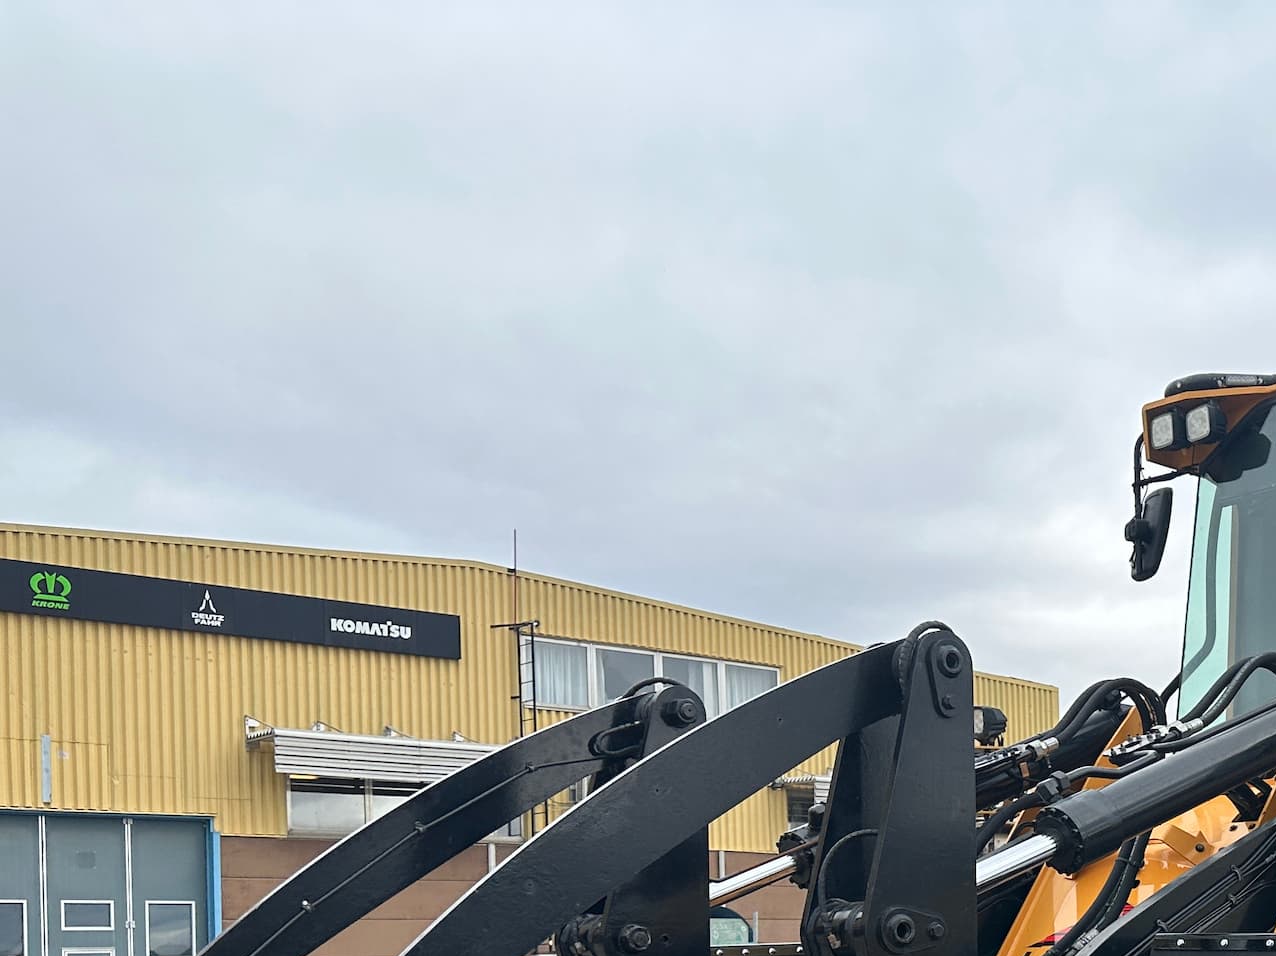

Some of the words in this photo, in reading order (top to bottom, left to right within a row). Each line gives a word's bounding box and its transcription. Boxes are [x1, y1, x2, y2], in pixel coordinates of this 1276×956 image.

[31, 600, 71, 610] KRONE
[191, 611, 225, 622] DEUTZ
[194, 618, 221, 627] FAHR
[330, 617, 412, 639] KOMATSU
